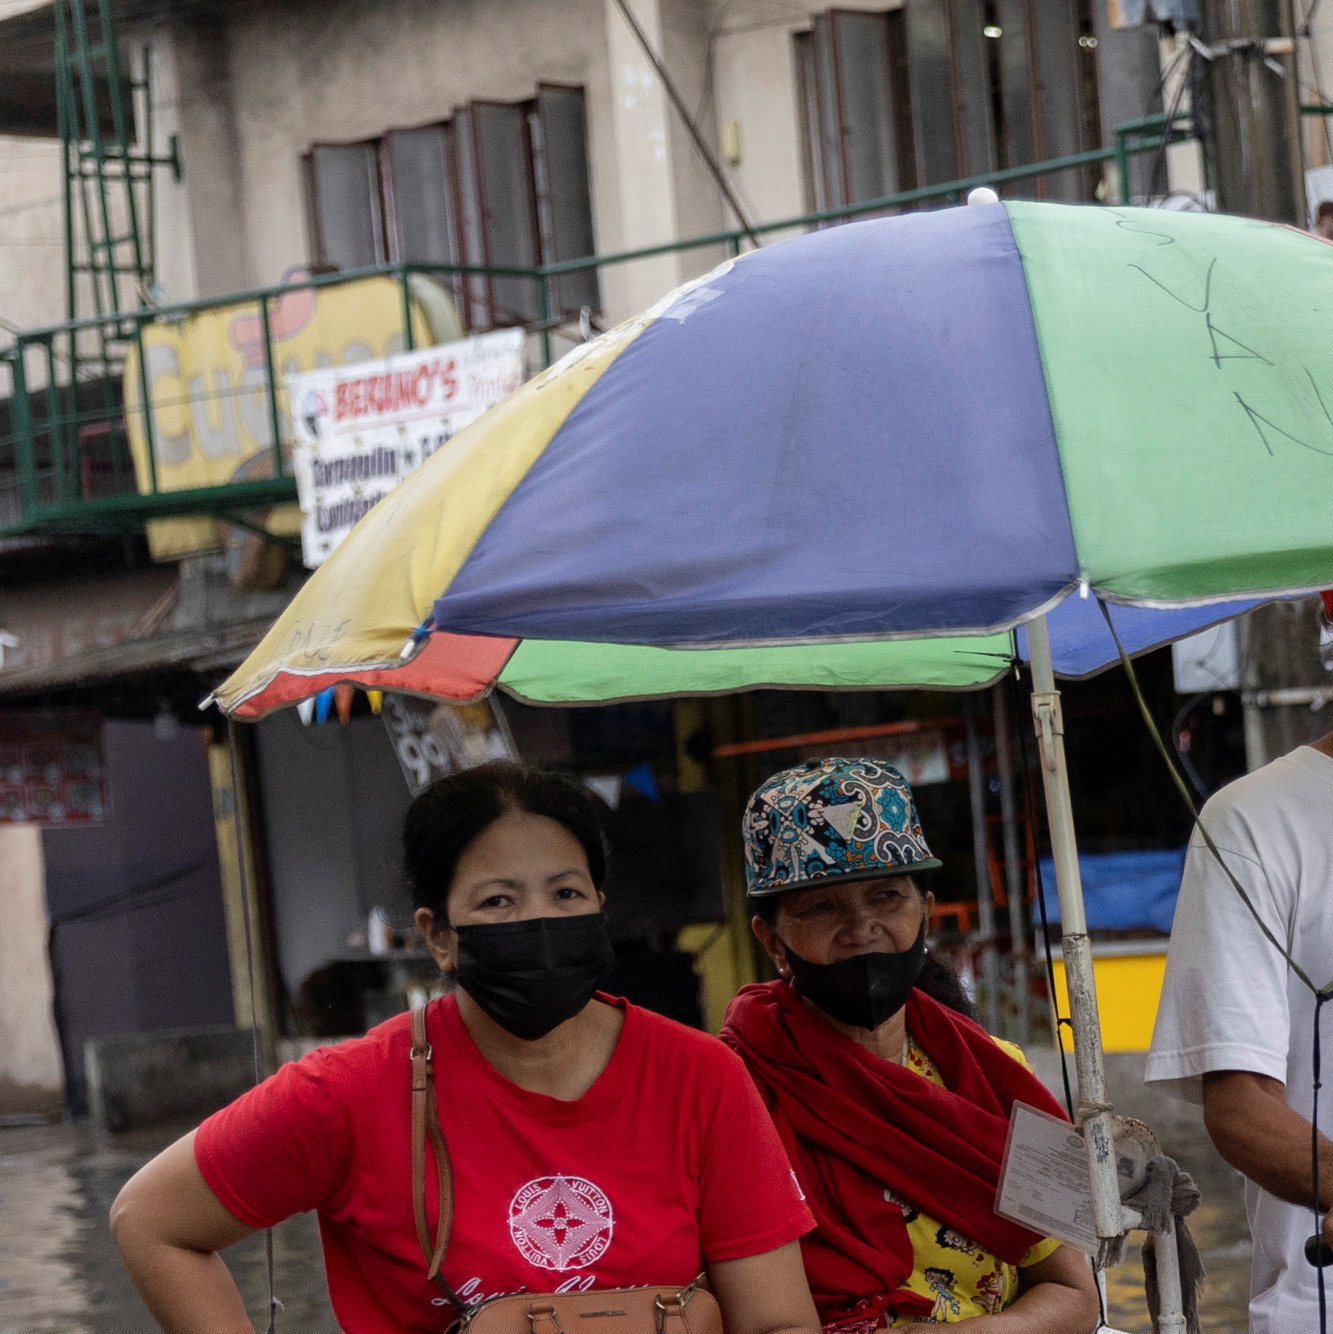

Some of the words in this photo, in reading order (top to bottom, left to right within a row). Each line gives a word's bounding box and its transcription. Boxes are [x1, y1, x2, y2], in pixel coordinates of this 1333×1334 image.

[514, 1182, 542, 1211] LOUIS
[572, 1180, 608, 1214] VUITTON
[514, 1229, 548, 1266] VUITTON
[579, 1236, 607, 1265] LOUIS
